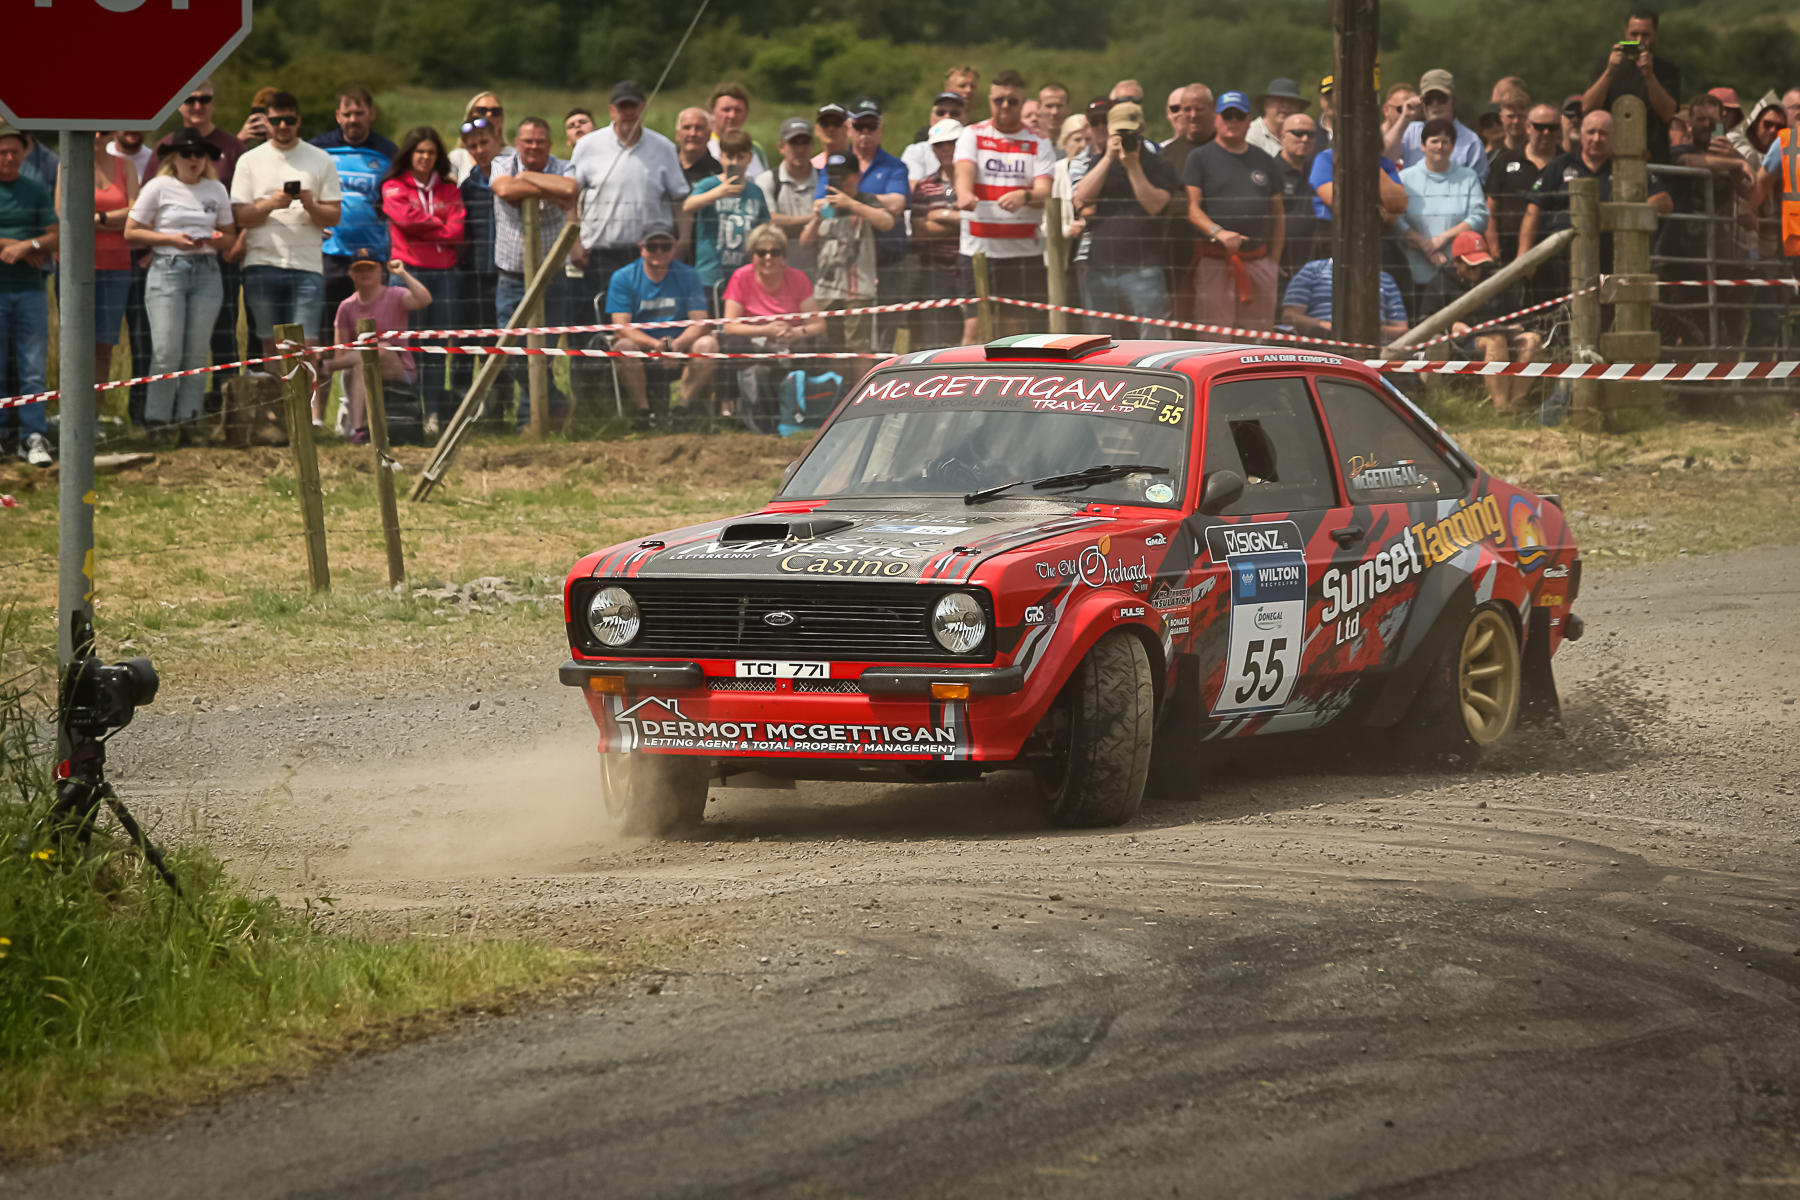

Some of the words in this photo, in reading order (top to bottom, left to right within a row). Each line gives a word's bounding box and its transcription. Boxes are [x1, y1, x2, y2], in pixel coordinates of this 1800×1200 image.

[986, 159, 1025, 173] Chill
[1240, 355, 1262, 364] CILL
[1263, 354, 1277, 362] AN
[1297, 355, 1342, 365] COMPLEX
[990, 399, 1024, 408] HIRE
[1032, 399, 1105, 413] TRAVEL
[1110, 404, 1135, 413] LTD
[1158, 404, 1185, 425] 55
[1347, 452, 1379, 478] Dale
[678, 541, 937, 558] MAJESTIC
[781, 553, 909, 576] Casino
[1035, 561, 1056, 578] The
[1058, 559, 1076, 575] Old
[1259, 566, 1299, 582] WILTON
[1152, 596, 1191, 608] INSULATION
[1025, 605, 1044, 624] GRS
[1120, 607, 1145, 617] PULSE
[1258, 611, 1283, 622] DONEGAL
[1170, 617, 1190, 626] BONAR'S
[1336, 612, 1359, 645] Ltd
[742, 663, 777, 676] TCI
[788, 663, 824, 676] 771
[1235, 637, 1288, 704] 55
[641, 720, 757, 739] DERMOT
[766, 723, 956, 743] MCGETTIGAN
[644, 738, 693, 747] LETTING
[696, 740, 738, 748] AGENT
[740, 741, 749, 749] &
[752, 741, 790, 750] TOTAL
[794, 741, 861, 752] PROPERTY
[864, 743, 956, 753] MANAGEMENT
